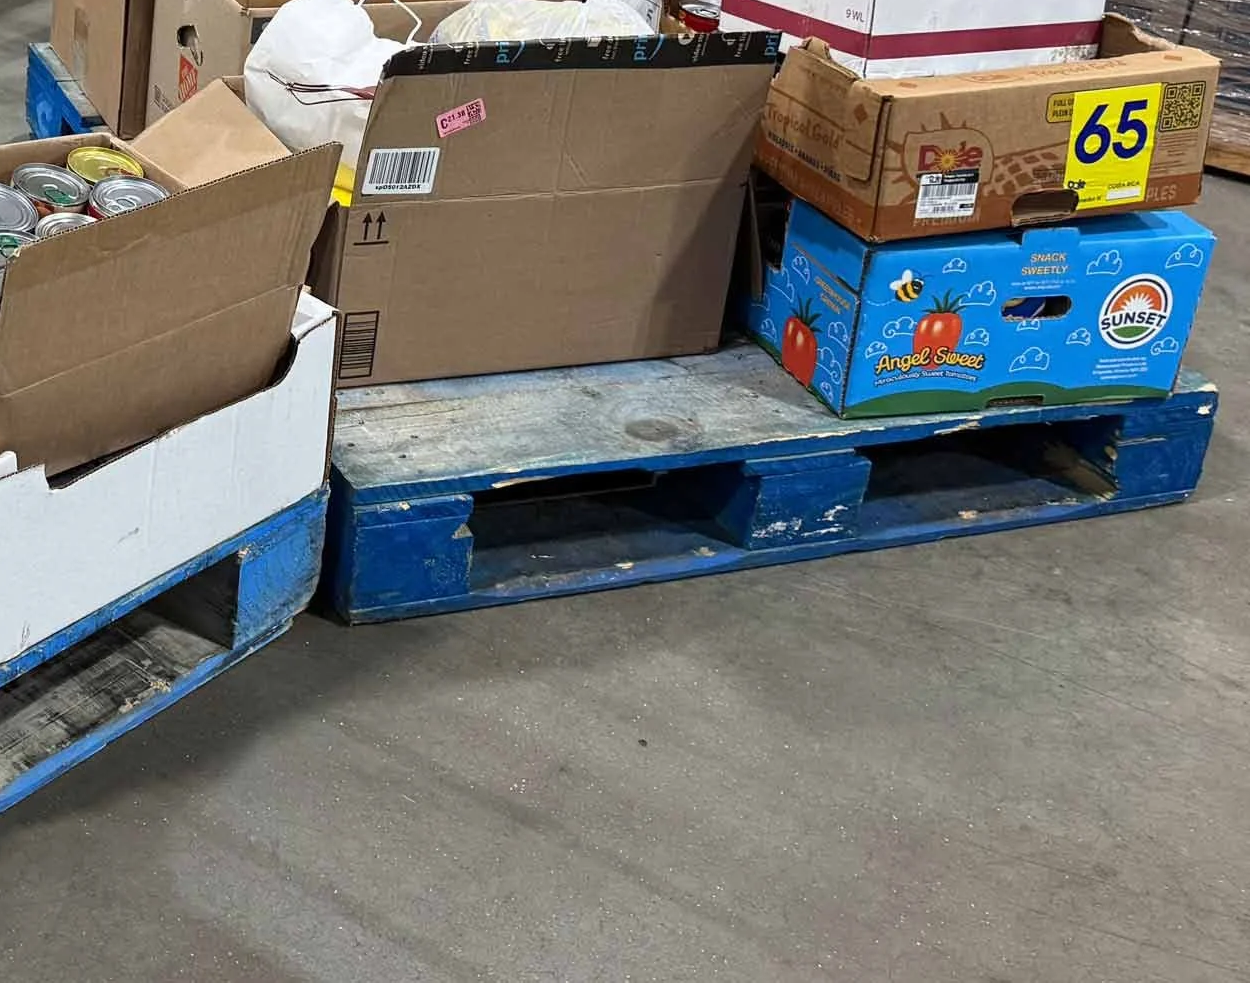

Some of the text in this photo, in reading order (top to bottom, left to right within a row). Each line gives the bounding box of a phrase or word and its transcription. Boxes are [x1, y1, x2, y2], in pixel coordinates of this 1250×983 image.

[845, 9, 852, 18] 9
[765, 102, 841, 149] Tropical Gold
[1075, 99, 1148, 164] 65
[1030, 253, 1067, 263] SNACK
[1021, 265, 1069, 276] SWEETLY
[1100, 311, 1167, 331] SUNSET
[875, 347, 985, 375] Angel Sweet
